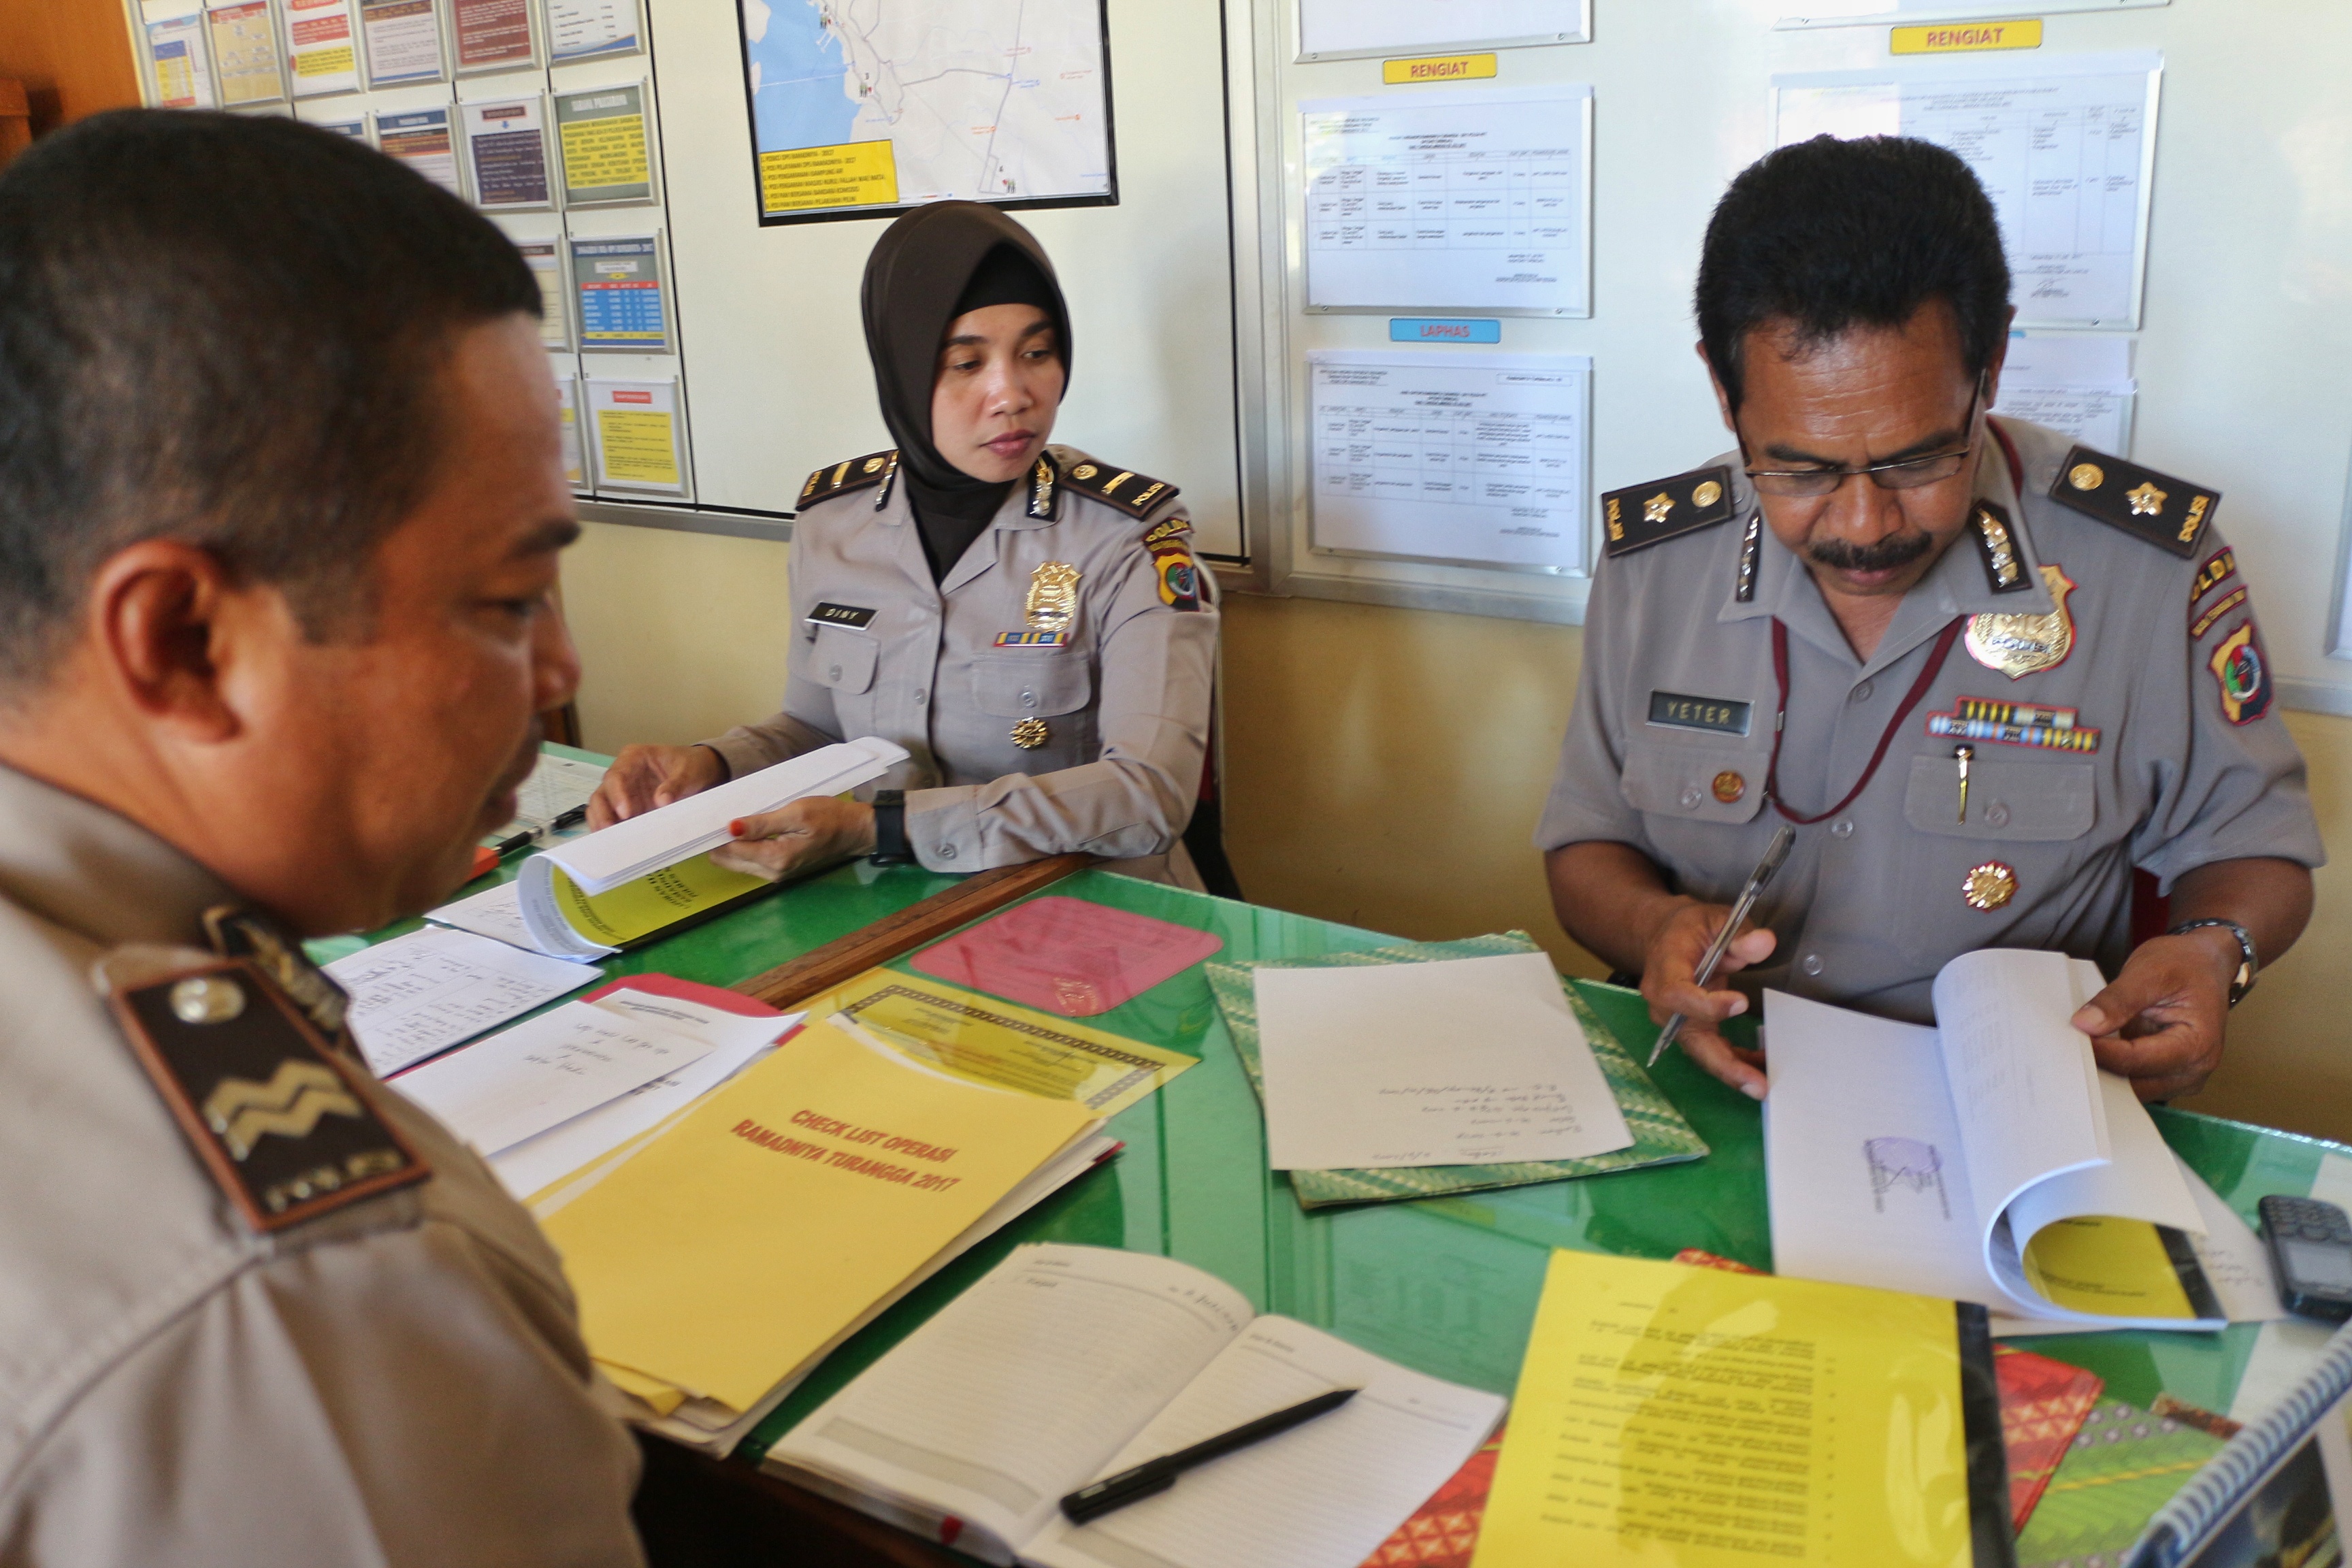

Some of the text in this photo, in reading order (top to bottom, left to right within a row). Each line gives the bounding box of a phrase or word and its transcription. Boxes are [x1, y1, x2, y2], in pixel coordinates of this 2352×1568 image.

[1927, 27, 2005, 46] RENGIAT
[1411, 61, 1469, 78] RENGIAT
[1420, 325, 1470, 338] LAPHAS
[1131, 482, 1165, 506] POLISI
[2177, 495, 2210, 543] POLISI
[825, 608, 859, 620] DINY
[1667, 701, 1731, 725] YETER
[790, 1109, 958, 1163] CHECK LIST OPERASI
[730, 1119, 962, 1192] RAMADNIYA TURANGGA 2017
